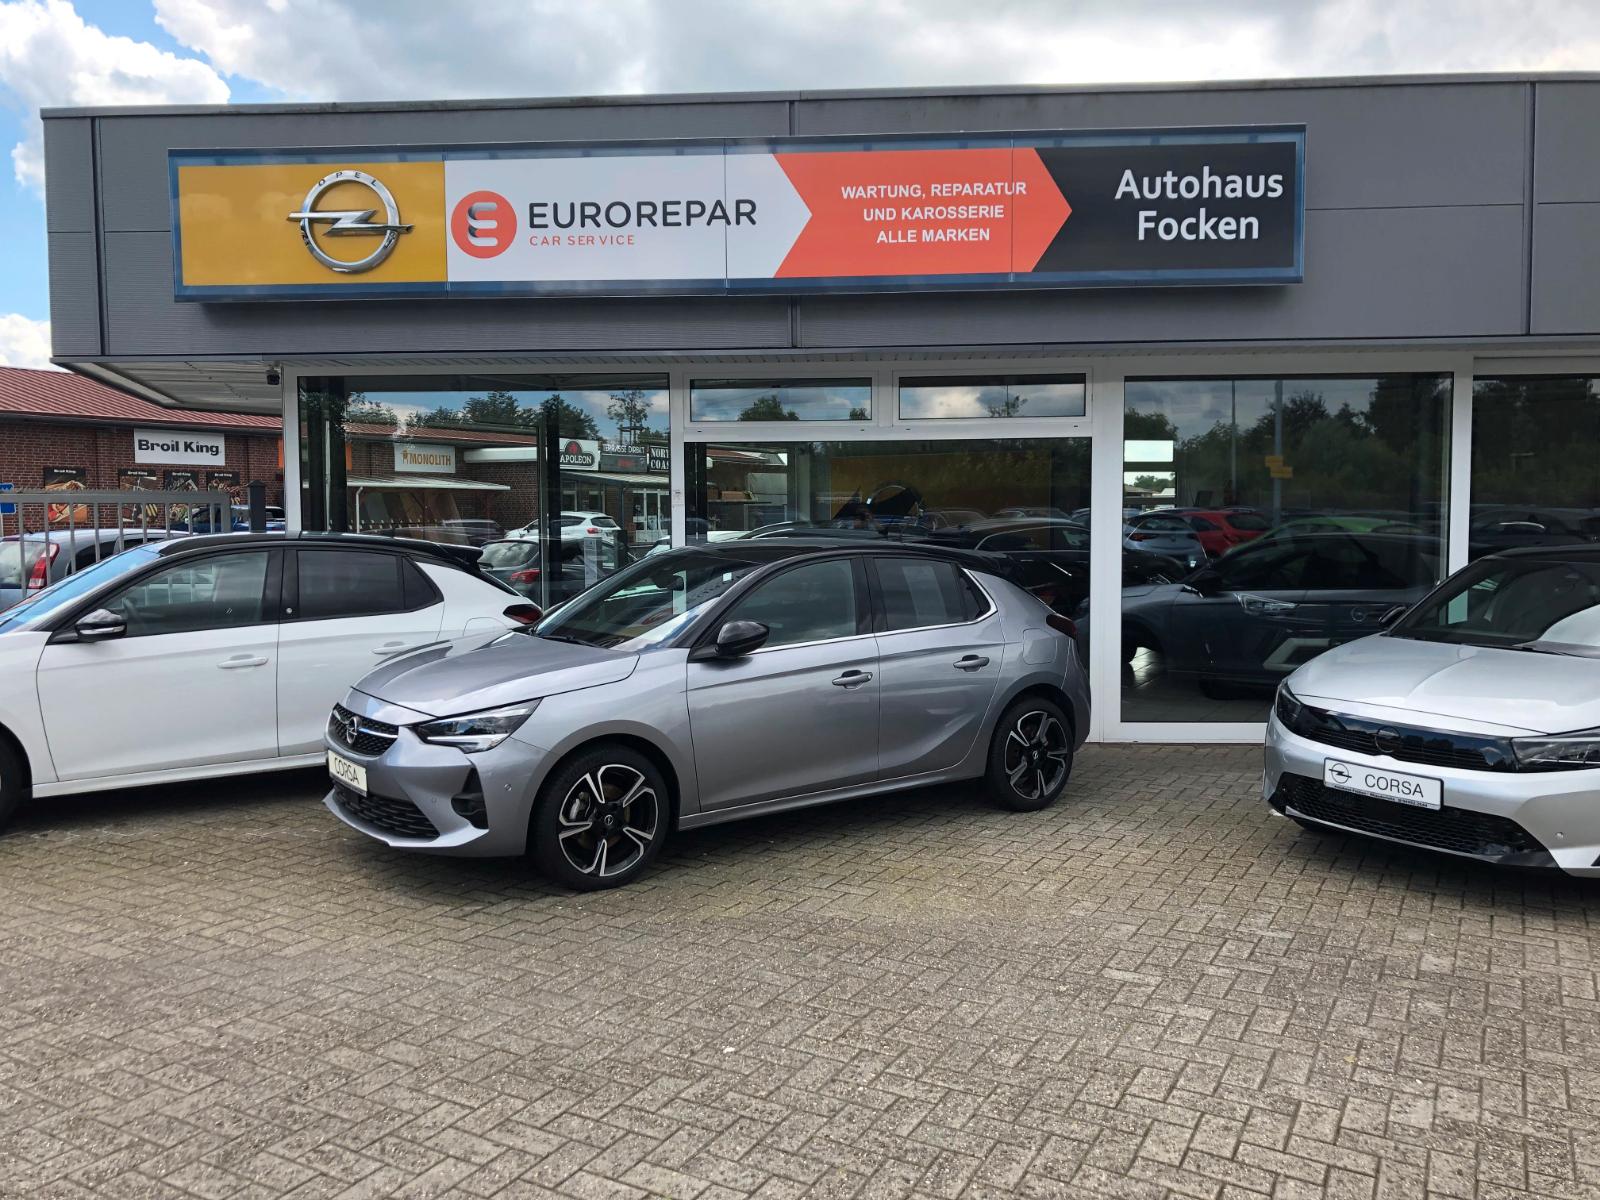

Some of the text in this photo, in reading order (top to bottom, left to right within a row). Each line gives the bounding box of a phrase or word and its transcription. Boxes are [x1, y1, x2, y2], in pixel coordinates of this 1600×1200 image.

[317, 170, 378, 188] OPEL
[1114, 165, 1284, 200] Autohaus
[841, 182, 1027, 200] WARTUNG, REPARATUR
[528, 198, 757, 229] EUROREPAR
[863, 205, 1005, 222] UND KAROSSERIE
[1138, 207, 1259, 241] Focken
[529, 234, 636, 247] CAR SERVICE
[876, 228, 990, 244] ALLE MARKEN
[137, 439, 220, 456] Broil King
[409, 452, 452, 466] MONOLITH
[560, 454, 592, 464] APOLEON
[334, 757, 360, 785] CORSA
[1364, 773, 1424, 799] CORSA
